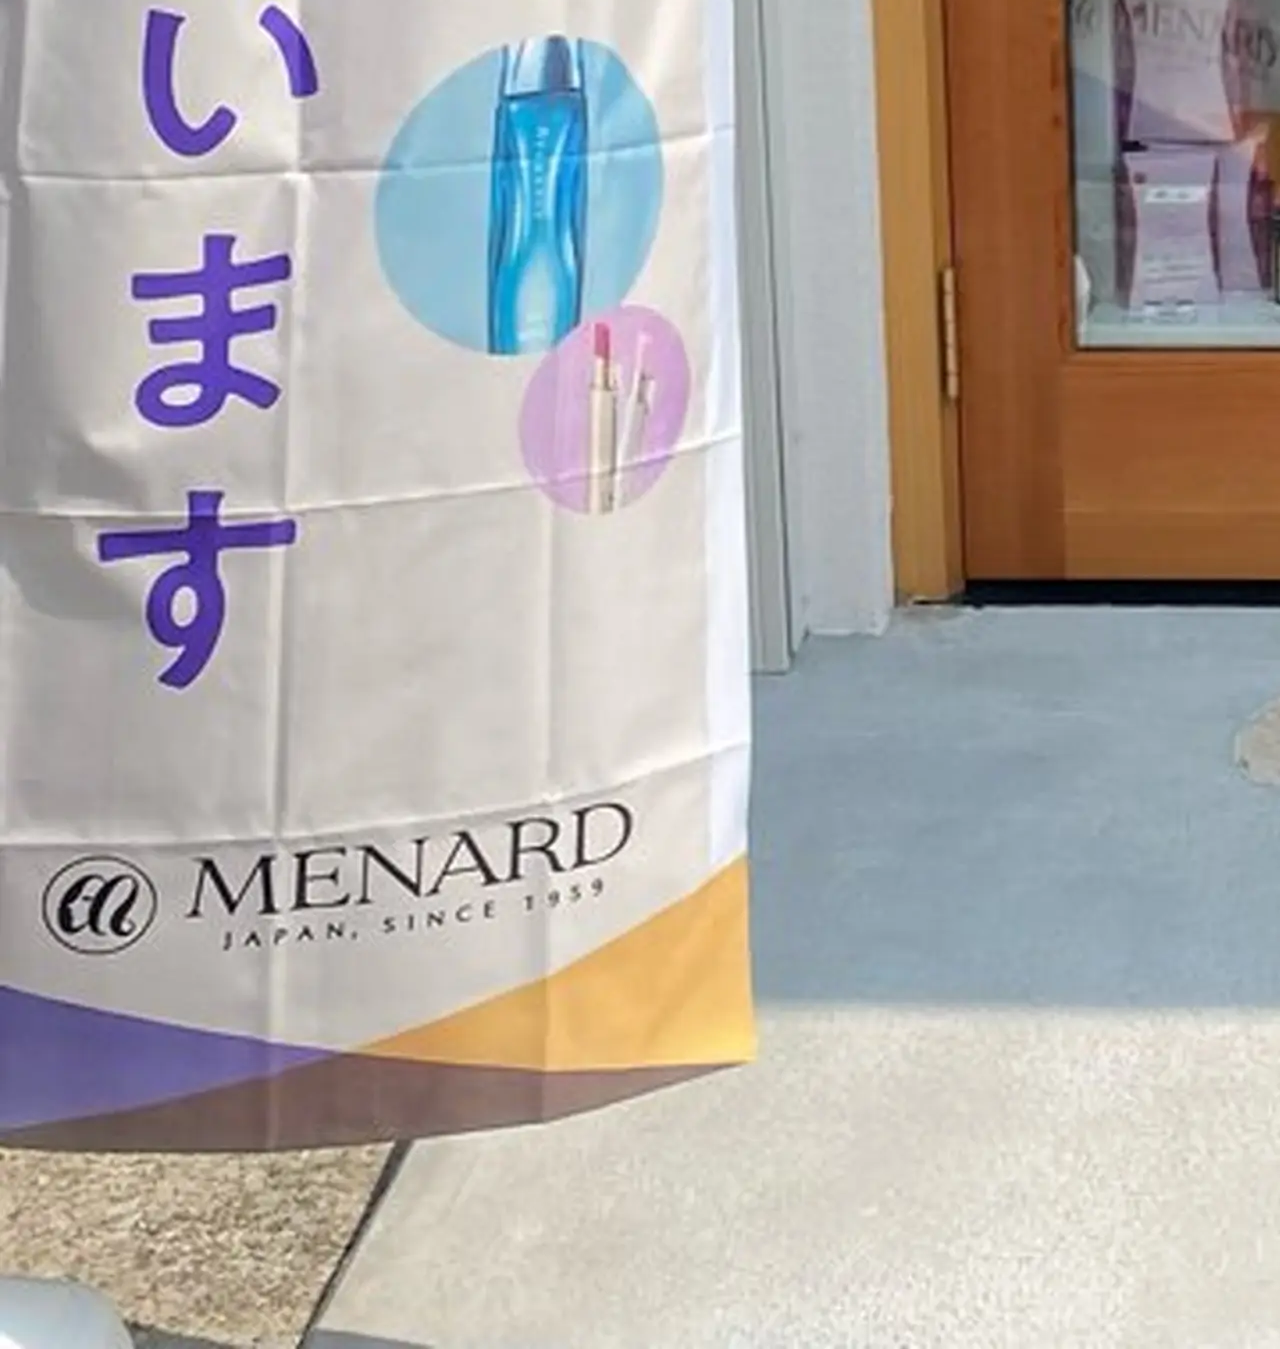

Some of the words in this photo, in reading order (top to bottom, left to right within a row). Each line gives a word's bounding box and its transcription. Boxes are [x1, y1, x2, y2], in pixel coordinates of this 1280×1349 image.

[186, 802, 634, 919] MENARD
[221, 920, 360, 952] JAPAN,
[382, 901, 497, 936] SINCE
[523, 877, 606, 912] 1959
